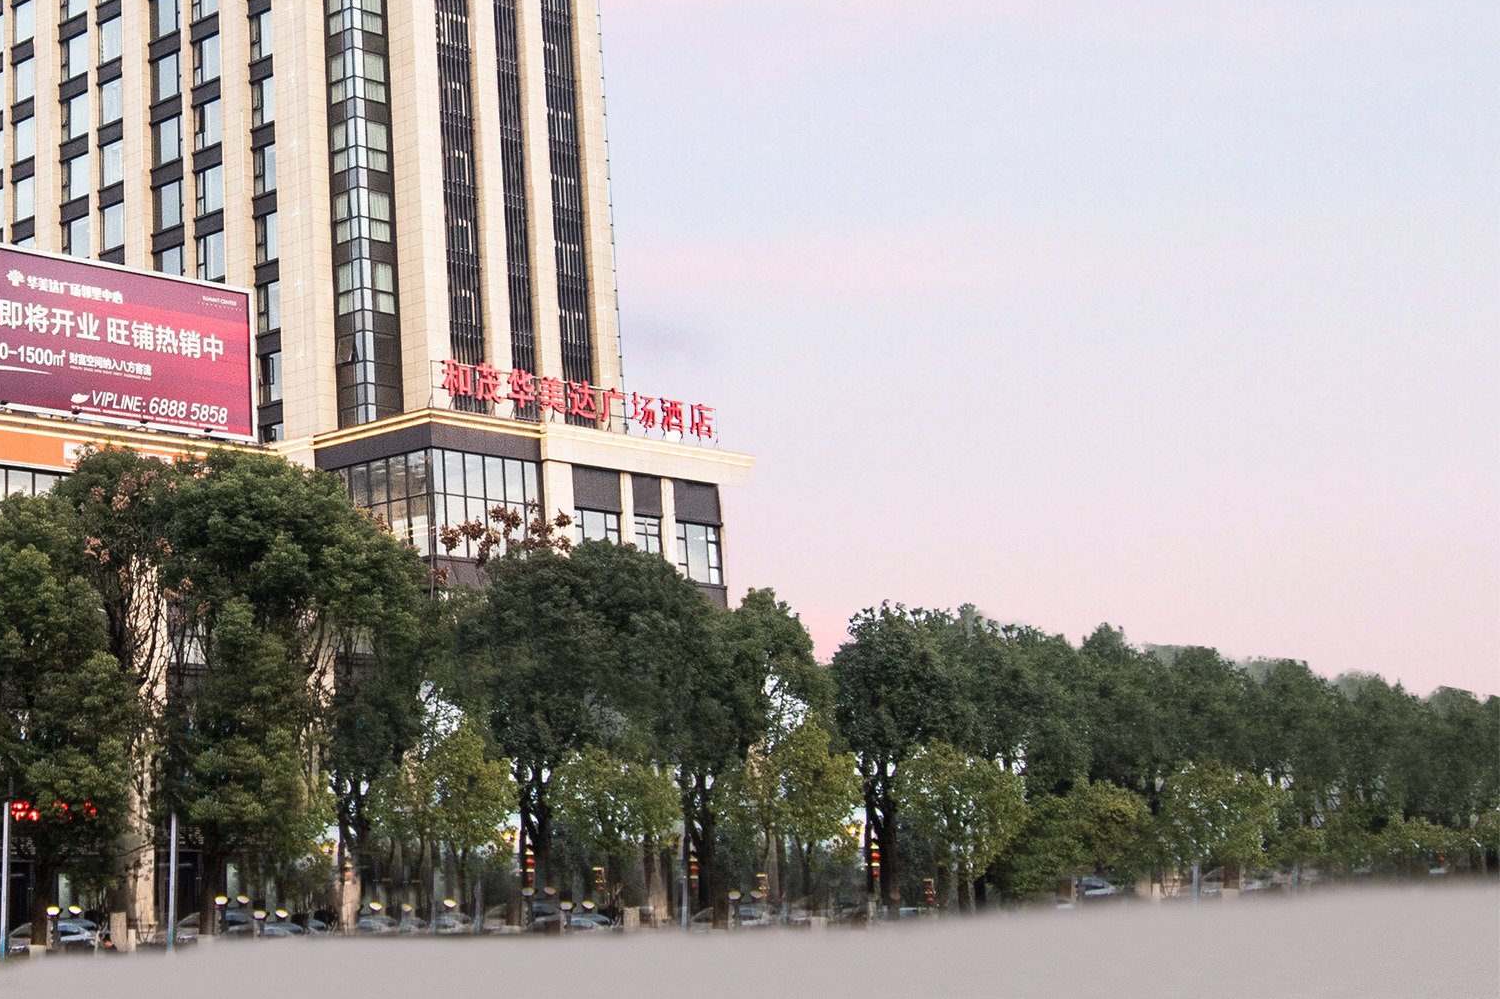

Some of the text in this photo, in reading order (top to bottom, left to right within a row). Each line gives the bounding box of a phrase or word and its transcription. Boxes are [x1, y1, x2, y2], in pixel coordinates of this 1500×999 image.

[106, 317, 224, 362] 旺铺热销中
[92, 389, 146, 414] VIPLINE:
[149, 396, 187, 419] 6888
[189, 402, 228, 425] 5858
[441, 359, 716, 439] 和茂华美达广场酒店
